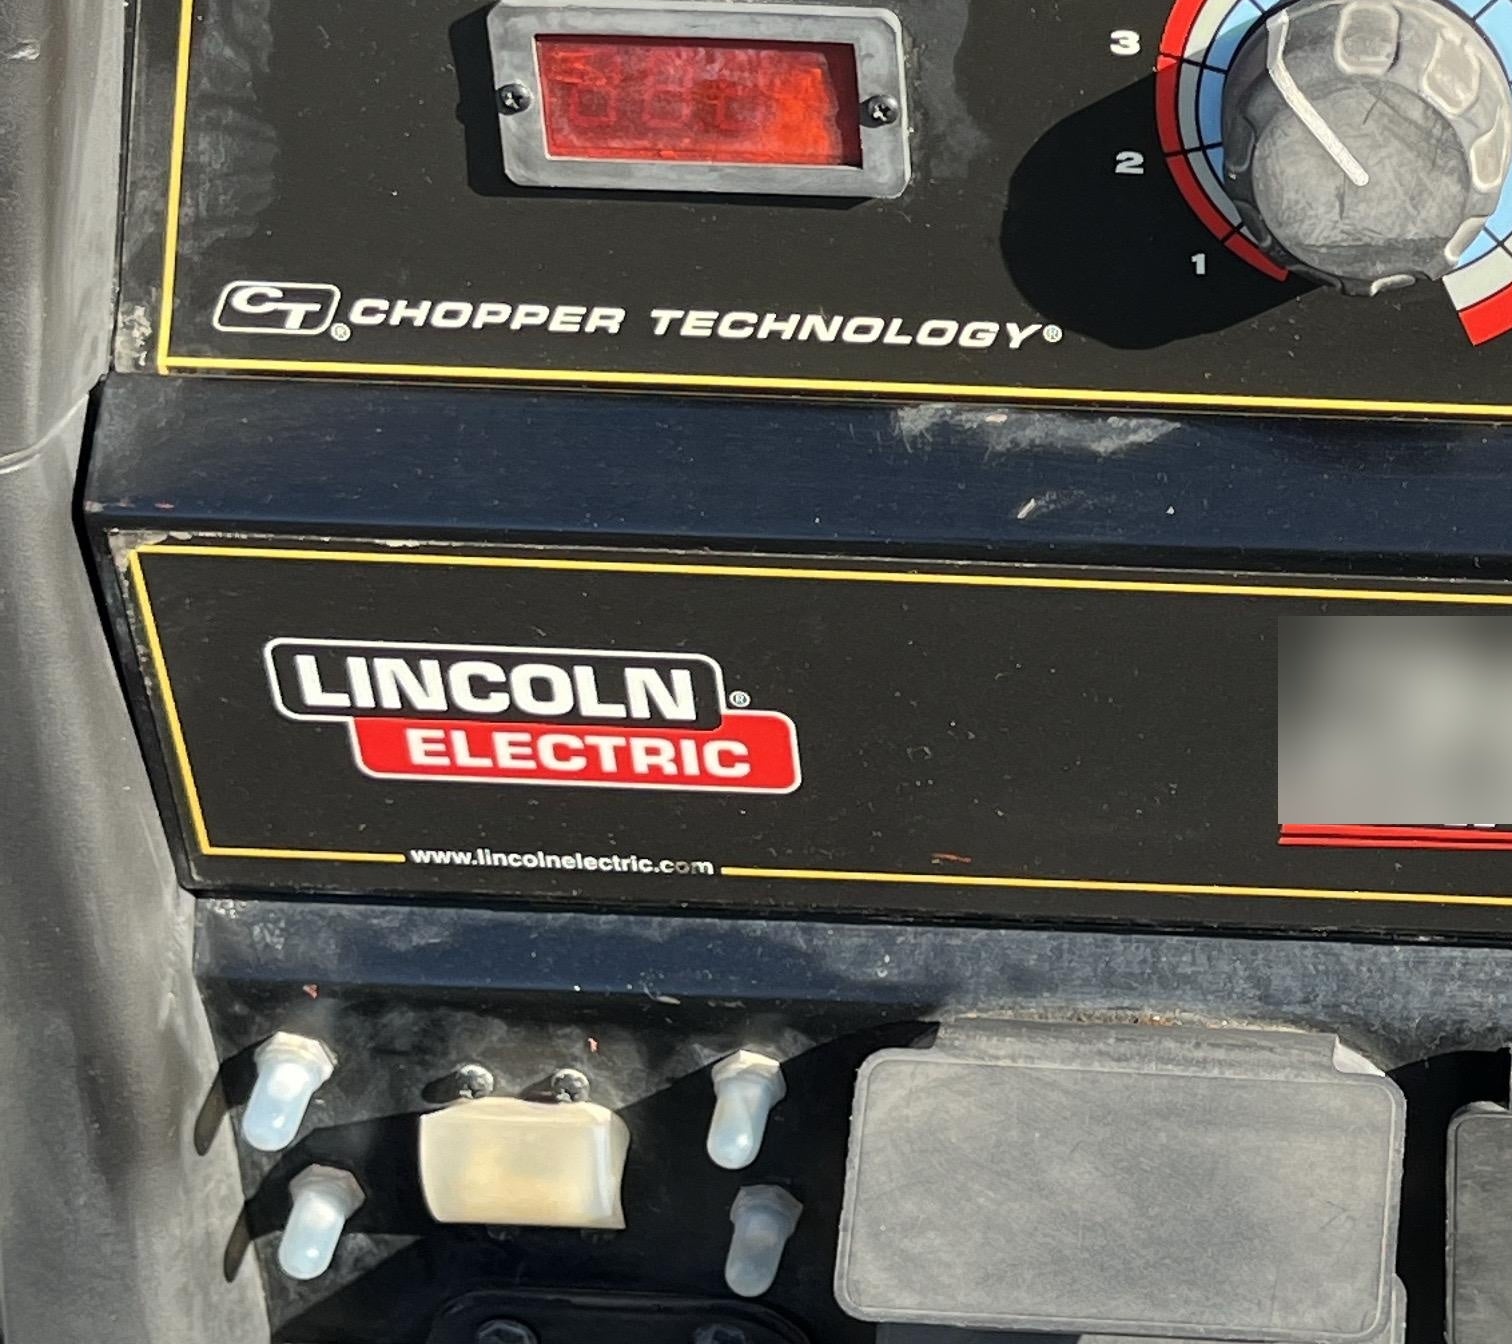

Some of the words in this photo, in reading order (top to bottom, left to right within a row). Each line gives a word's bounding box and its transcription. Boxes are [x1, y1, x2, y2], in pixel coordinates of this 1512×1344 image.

[1109, 30, 1141, 56] 3
[1114, 151, 1146, 175] 2
[1190, 252, 1206, 275] 1
[346, 296, 624, 335] CHOPPER
[295, 653, 699, 722] LINCOLN
[404, 727, 752, 778] ELECTRIC
[410, 846, 715, 876] www.lincolnelectric.com
